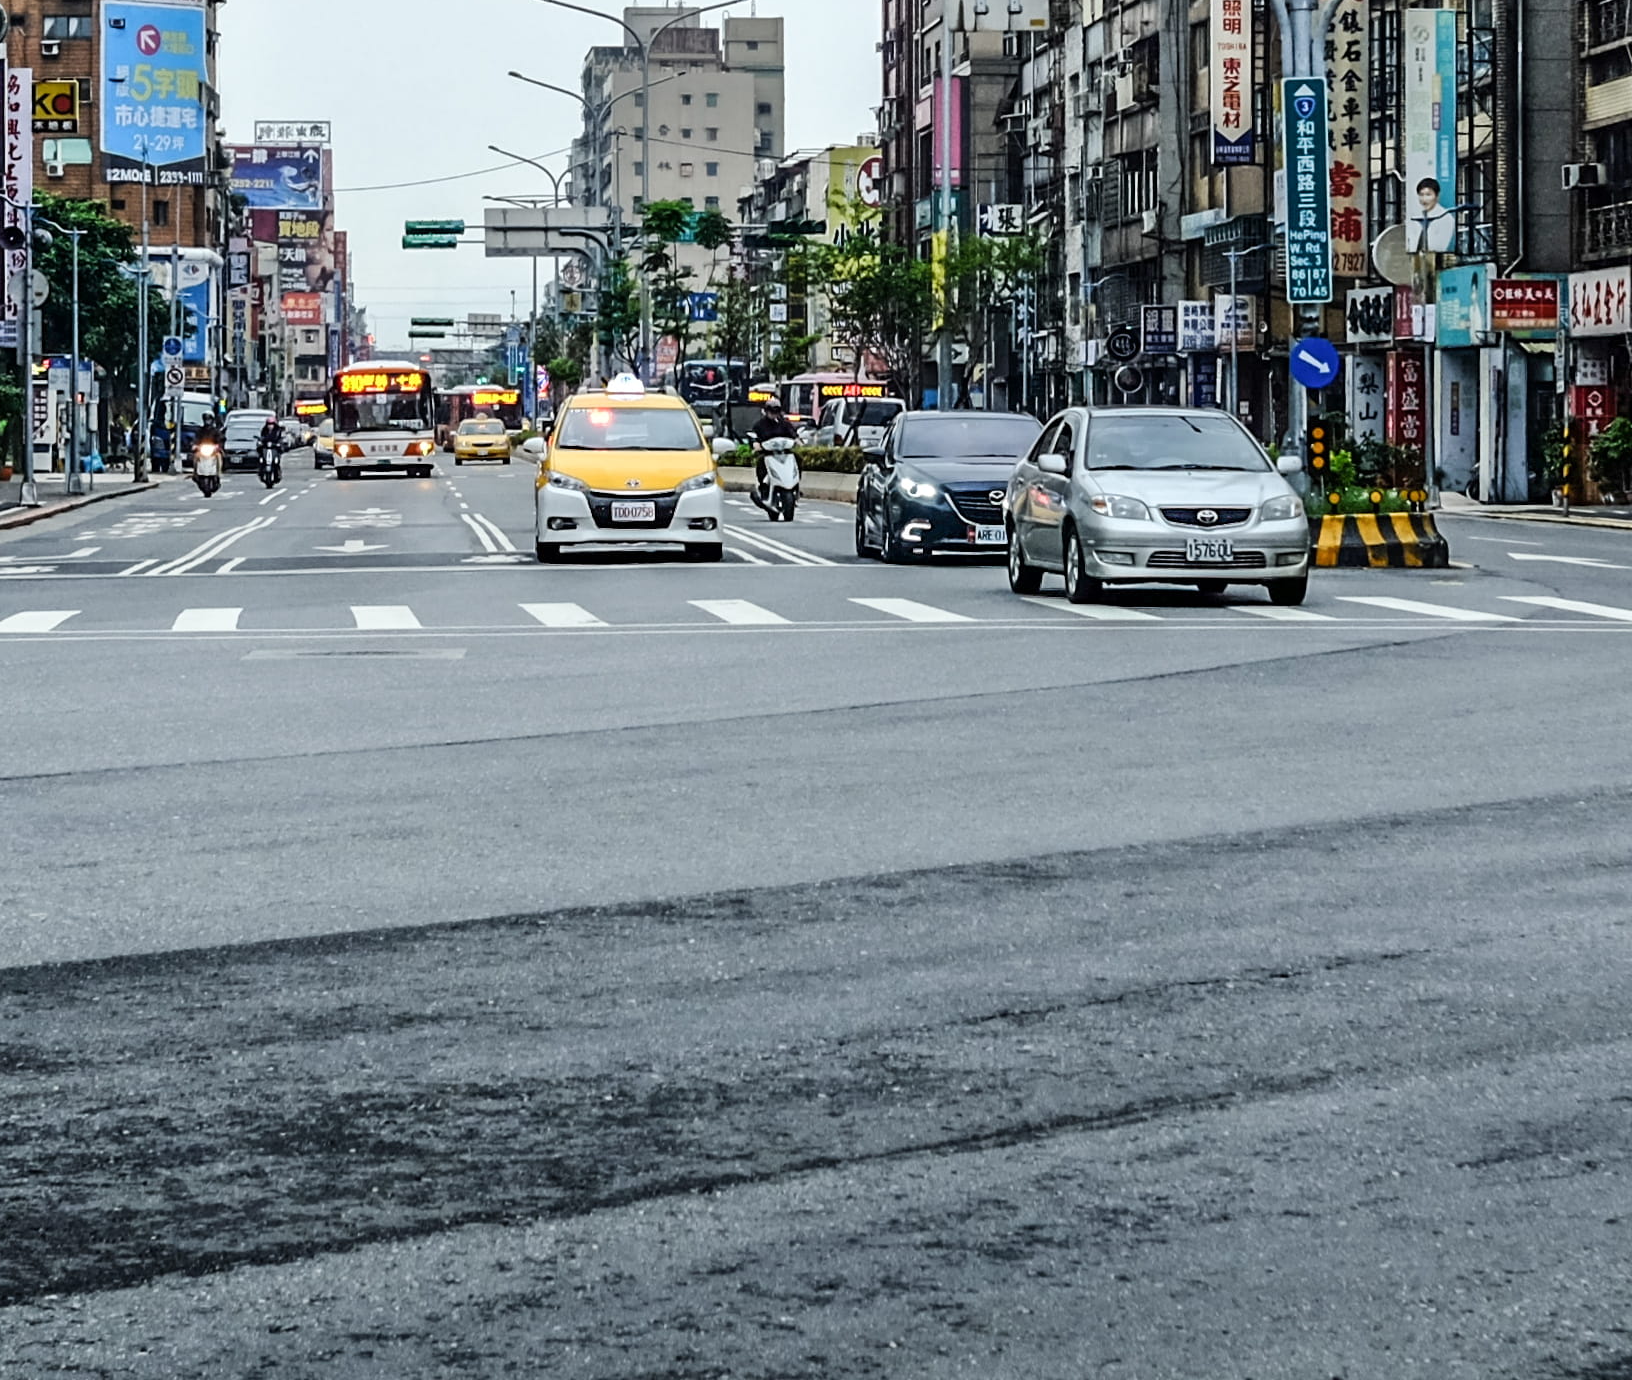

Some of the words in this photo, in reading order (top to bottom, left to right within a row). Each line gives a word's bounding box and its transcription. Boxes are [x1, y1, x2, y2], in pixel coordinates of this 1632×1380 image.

[1300, 100, 1309, 110] 3
[1296, 119, 1317, 227] 和平西路三段
[1290, 230, 1327, 242] HePing
[1291, 244, 1302, 253] W.
[1306, 243, 1322, 253] Rd.
[1291, 255, 1312, 267] Sec.
[1315, 256, 1322, 266] 3
[1292, 270, 1306, 279] 86
[1313, 270, 1326, 279] 87
[1292, 287, 1306, 297] 70
[1313, 286, 1327, 297] 45
[1400, 358, 1422, 453] 富盛當
